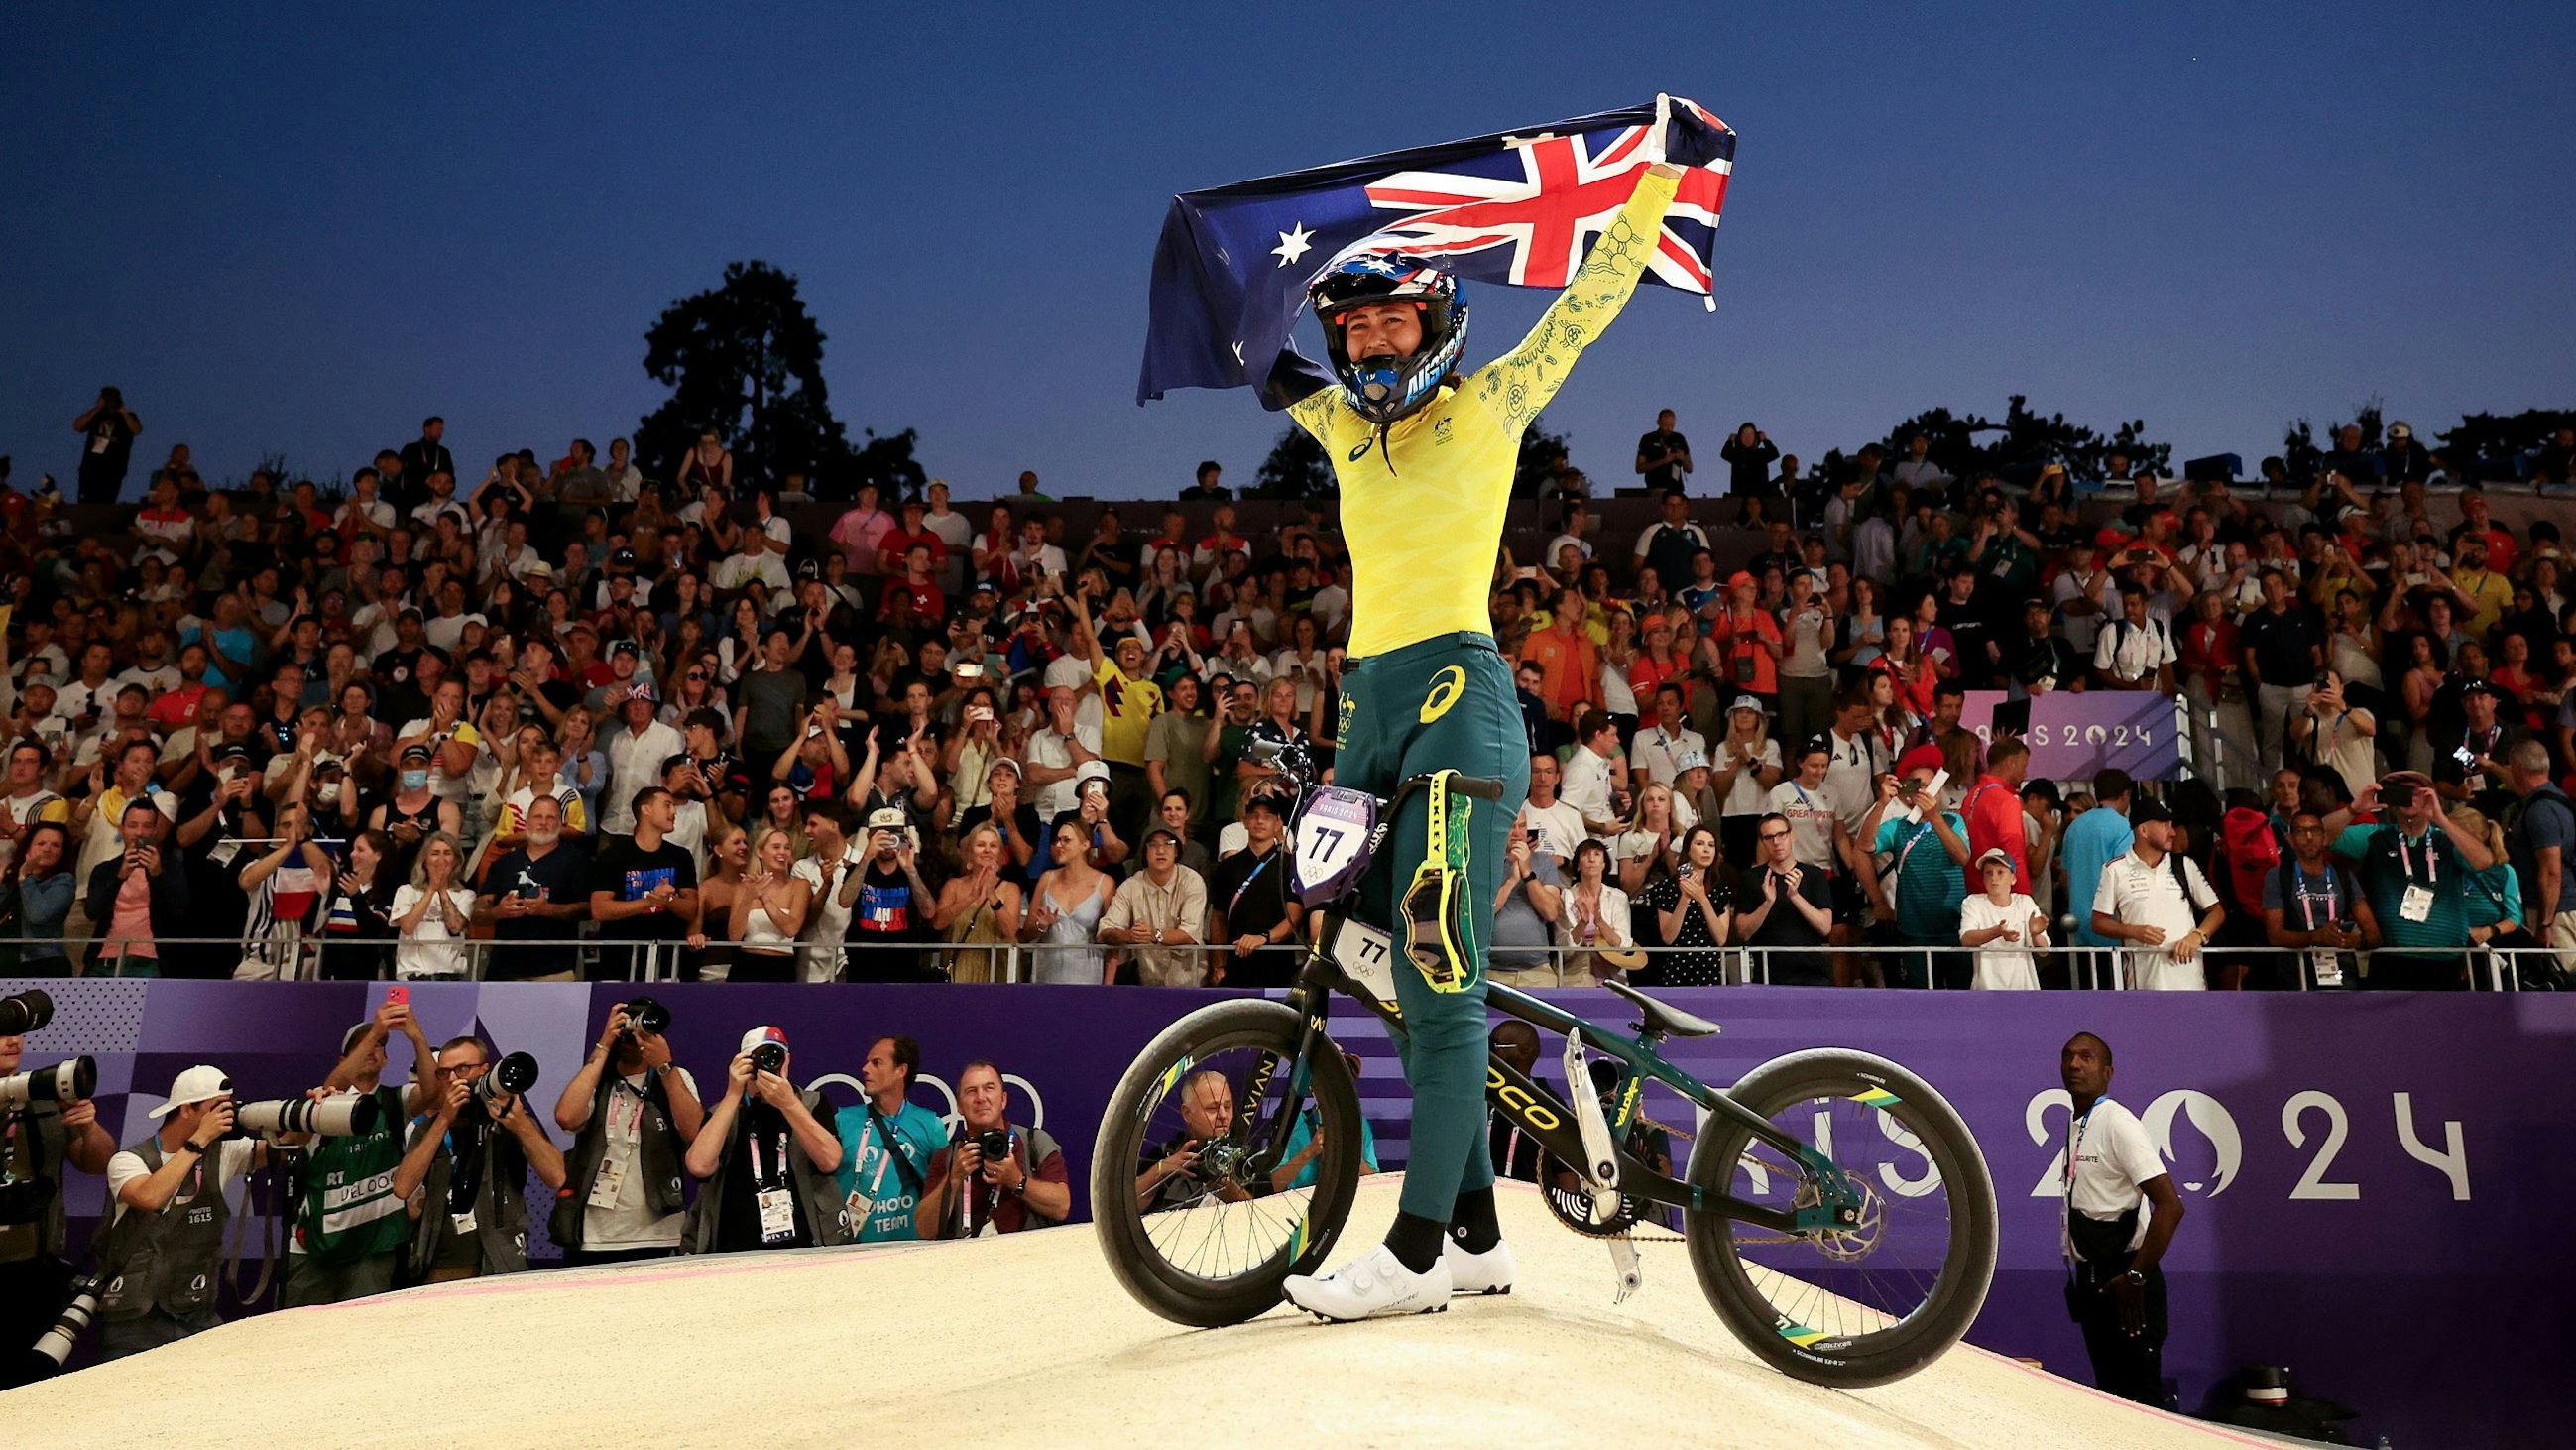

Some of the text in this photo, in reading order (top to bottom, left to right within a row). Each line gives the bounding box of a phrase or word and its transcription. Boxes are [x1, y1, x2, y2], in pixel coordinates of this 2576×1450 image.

[2063, 725, 2151, 746] 2024
[1319, 803, 1358, 820] PARIS 2024
[1787, 809, 1813, 818] GREAT
[1309, 826, 1345, 863] 77
[1359, 937, 1387, 964] 77
[189, 1212, 213, 1224] 1615
[874, 1214, 908, 1233] TEAM
